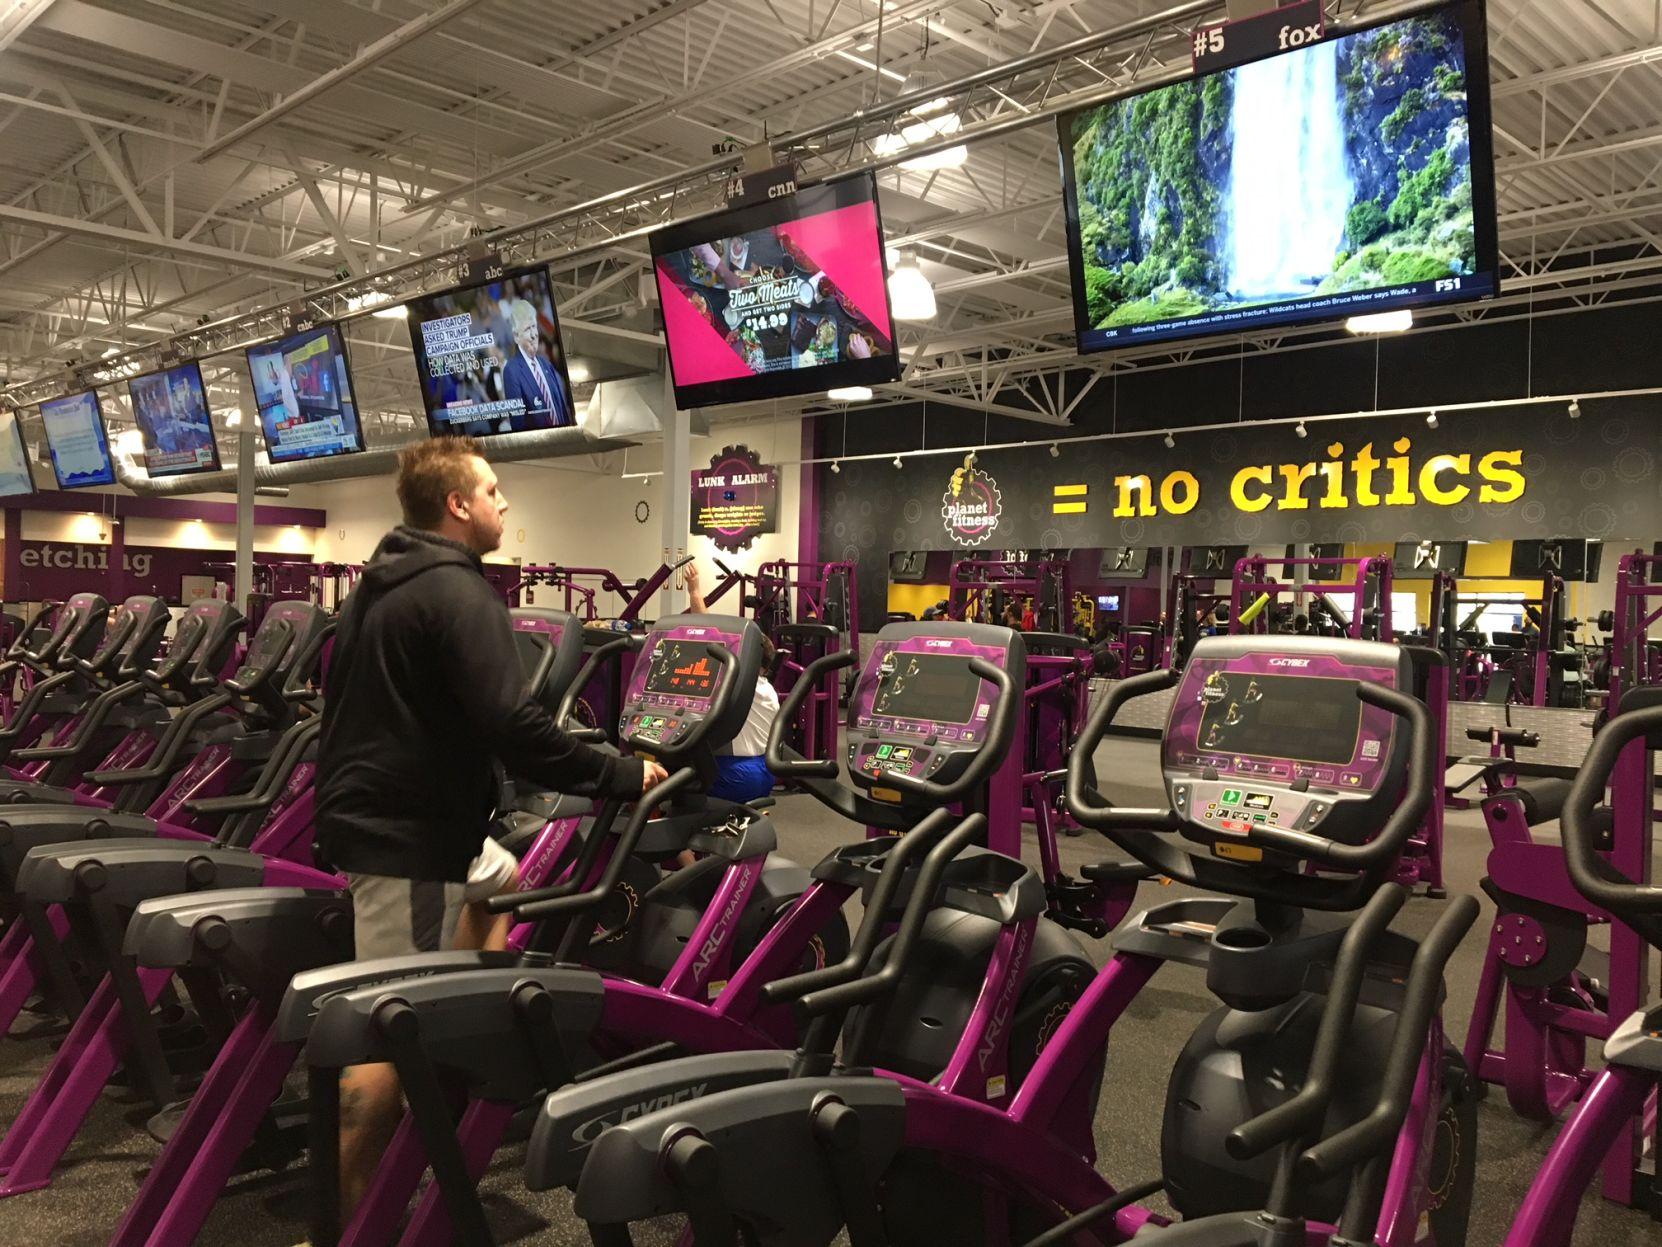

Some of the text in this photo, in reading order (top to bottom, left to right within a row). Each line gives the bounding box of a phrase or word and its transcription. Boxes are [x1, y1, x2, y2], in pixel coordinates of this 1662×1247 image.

[1193, 23, 1322, 57] #5 fox
[727, 179, 797, 199] #4 cnn
[458, 263, 503, 280] #3 abc
[750, 273, 774, 283] CHOOSE
[728, 280, 799, 309] Two Meats
[1435, 278, 1461, 293] FS1
[776, 302, 791, 310] SIDES
[1106, 330, 1118, 338] CBK
[1132, 325, 1156, 334] following
[1156, 320, 1187, 331] three-game
[1187, 317, 1211, 326] absence
[1211, 314, 1224, 323] with
[1224, 312, 1242, 321] stress
[1242, 308, 1268, 318] fracture:
[1269, 303, 1295, 315] Wildcats
[1296, 302, 1311, 310] head
[1312, 299, 1331, 308] coach
[1332, 297, 1351, 305] Bruce
[1352, 293, 1373, 302] Weber
[1374, 291, 1389, 300] says
[1390, 288, 1411, 297] Wade,
[422, 315, 471, 332] INVESTIGATORS
[746, 312, 788, 331] $14.99
[424, 327, 468, 343] ASKED TRUMP
[426, 334, 493, 355] CAMPAIGN OFFICIALS
[428, 350, 475, 368] HOW DATA WAS
[430, 356, 499, 377] COLLECTED AND USED
[448, 398, 526, 417] FACEBOOK DATA SCANDAL
[698, 473, 768, 487] LUNK ALARM
[1113, 470, 1200, 517] no
[1231, 437, 1526, 512] critics
[947, 501, 988, 518] planet
[952, 514, 996, 527] fitness
